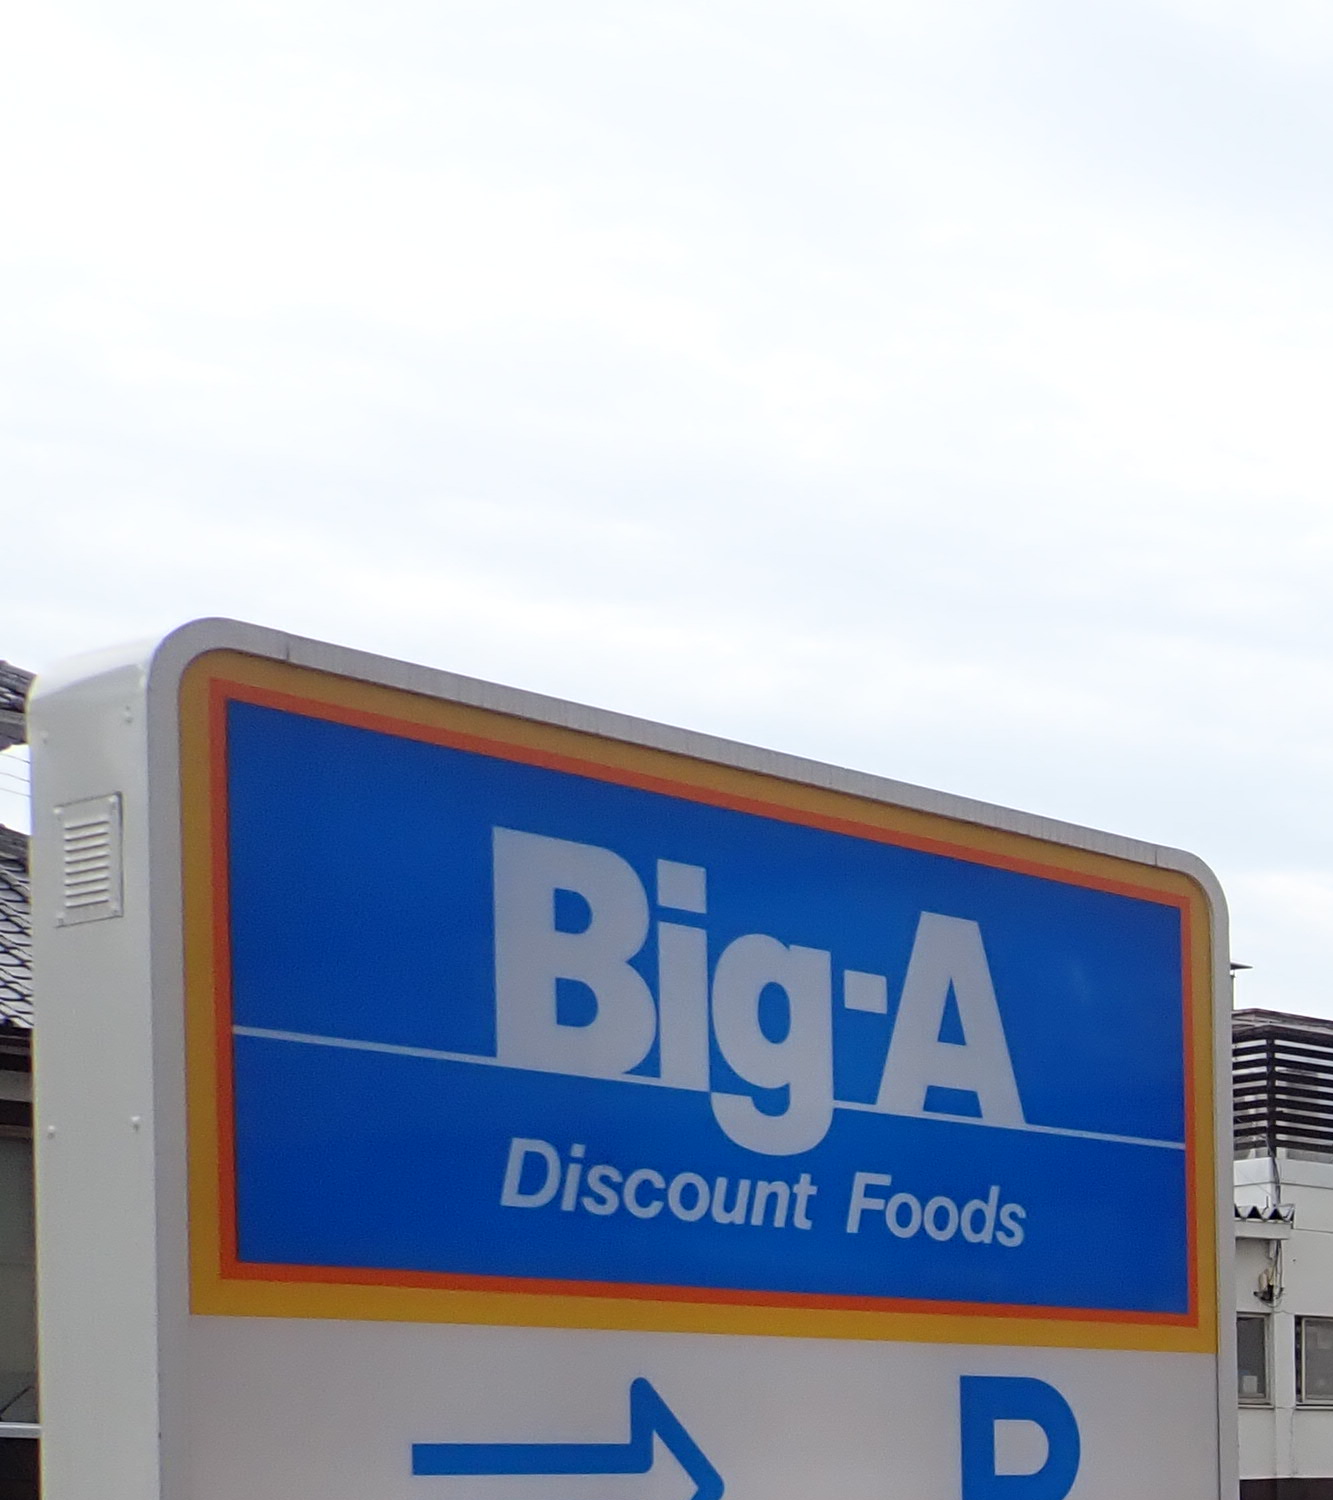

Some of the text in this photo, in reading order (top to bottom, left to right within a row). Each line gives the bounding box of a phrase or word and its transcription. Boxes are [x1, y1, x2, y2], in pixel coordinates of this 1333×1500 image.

[492, 827, 1025, 1156] Big-A
[501, 1137, 1028, 1249] Discount Foods
